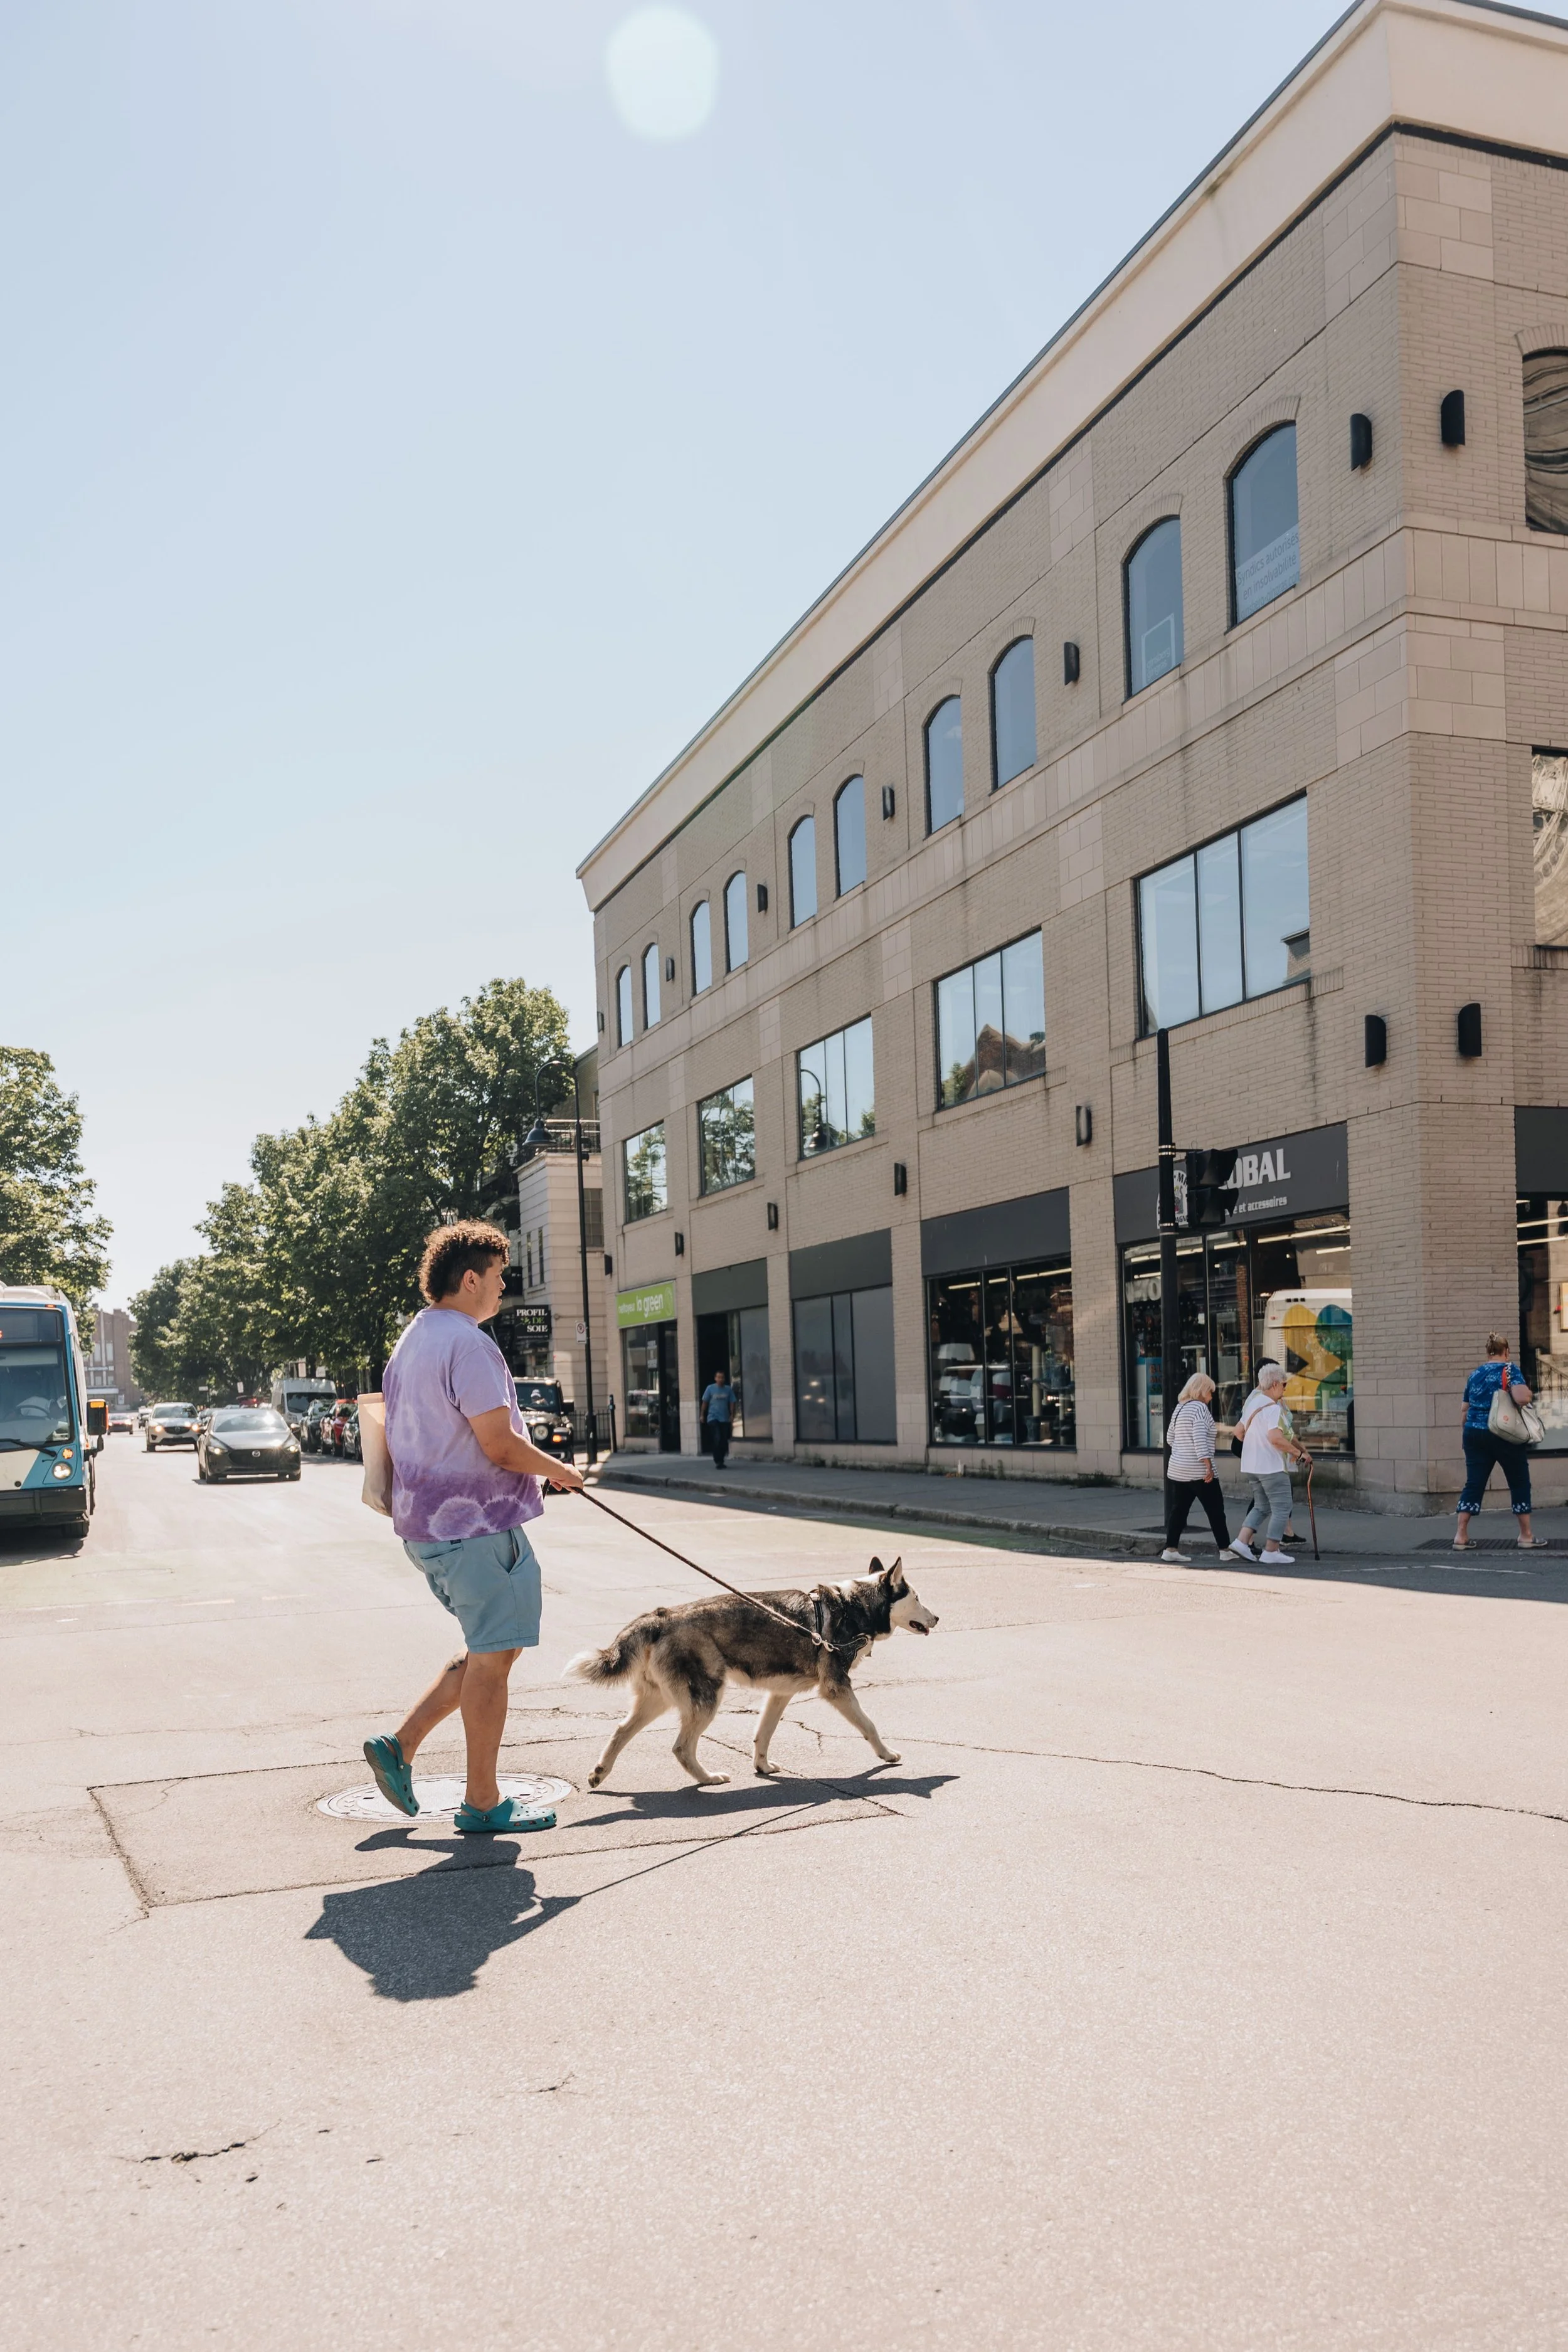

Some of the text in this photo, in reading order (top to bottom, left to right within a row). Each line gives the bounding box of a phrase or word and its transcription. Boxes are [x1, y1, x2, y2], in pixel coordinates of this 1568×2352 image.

[1237, 532, 1299, 586] Syndics autorisés
[1243, 550, 1297, 600] en insolvabilité
[1218, 1148, 1291, 1190] OBAL
[1238, 1202, 1246, 1214] et
[1248, 1195, 1288, 1212] accessoires
[516, 1308, 548, 1316] PROFIL
[644, 1294, 664, 1318] green
[526, 1325, 549, 1333] SOIE
